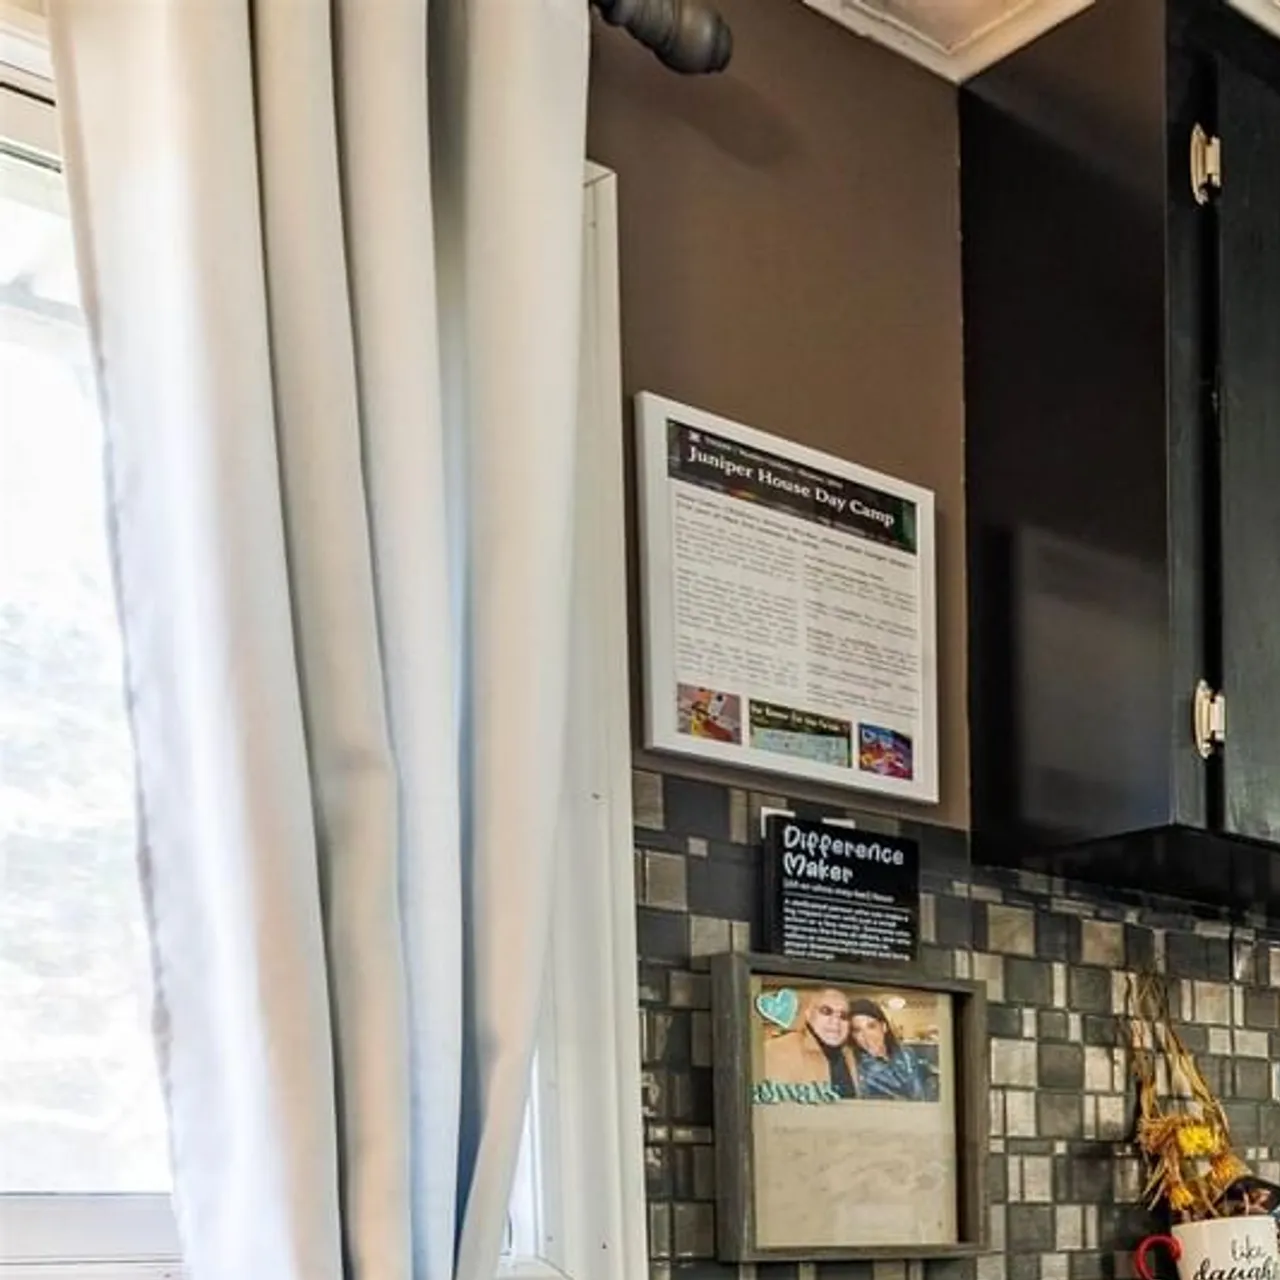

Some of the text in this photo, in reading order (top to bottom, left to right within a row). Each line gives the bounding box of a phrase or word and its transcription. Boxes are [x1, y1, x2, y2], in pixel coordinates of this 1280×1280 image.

[688, 445, 753, 479] Juniper
[757, 467, 811, 497] House
[814, 487, 847, 512] Day
[849, 499, 895, 528] Camp
[783, 825, 904, 866] Difference
[783, 852, 853, 884] Maker
